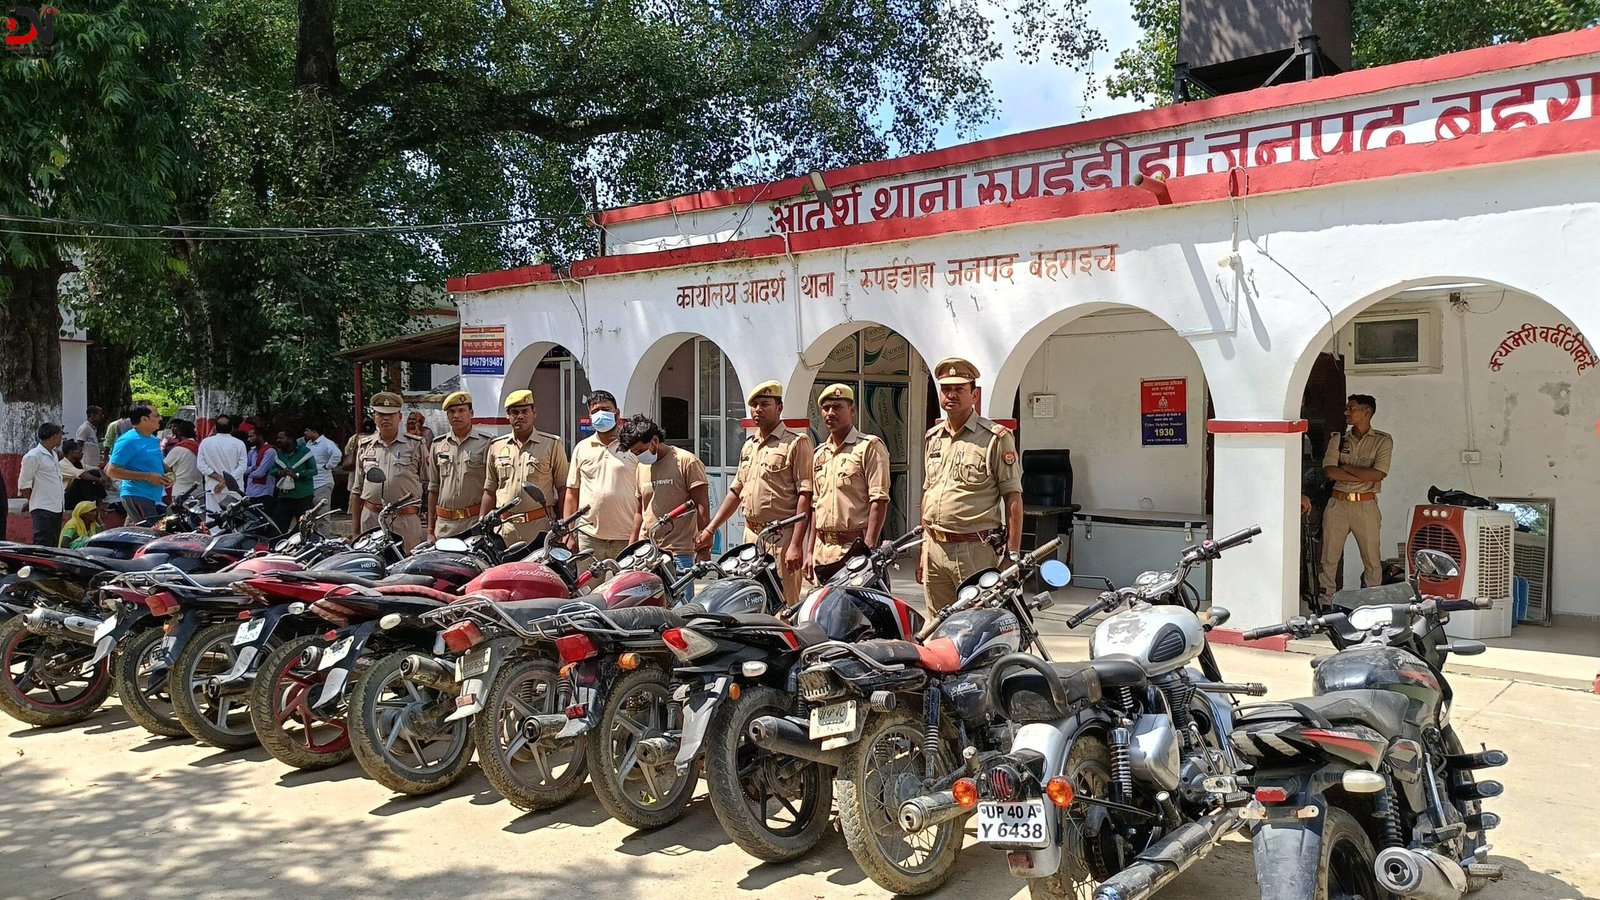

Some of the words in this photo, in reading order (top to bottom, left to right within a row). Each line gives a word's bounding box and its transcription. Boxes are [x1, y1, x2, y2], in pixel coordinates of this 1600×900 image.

[870, 174, 967, 221] थाना
[1204, 100, 1420, 173] जनपद
[676, 278, 738, 309] कार्यालय
[741, 275, 786, 304] आदर्श
[801, 272, 836, 299] थाना
[944, 253, 1020, 287] जनपद
[1029, 243, 1120, 281] बहराइच
[1506, 323, 1538, 348] मेरी
[1539, 323, 1573, 348] वर्दी
[1563, 332, 1591, 363] ठीक
[1154, 428, 1174, 436] 1930
[986, 805, 1004, 819] UP
[1007, 805, 1024, 819] 40
[1027, 805, 1037, 819] A
[981, 823, 993, 839] Y
[997, 822, 1043, 839] 6438
